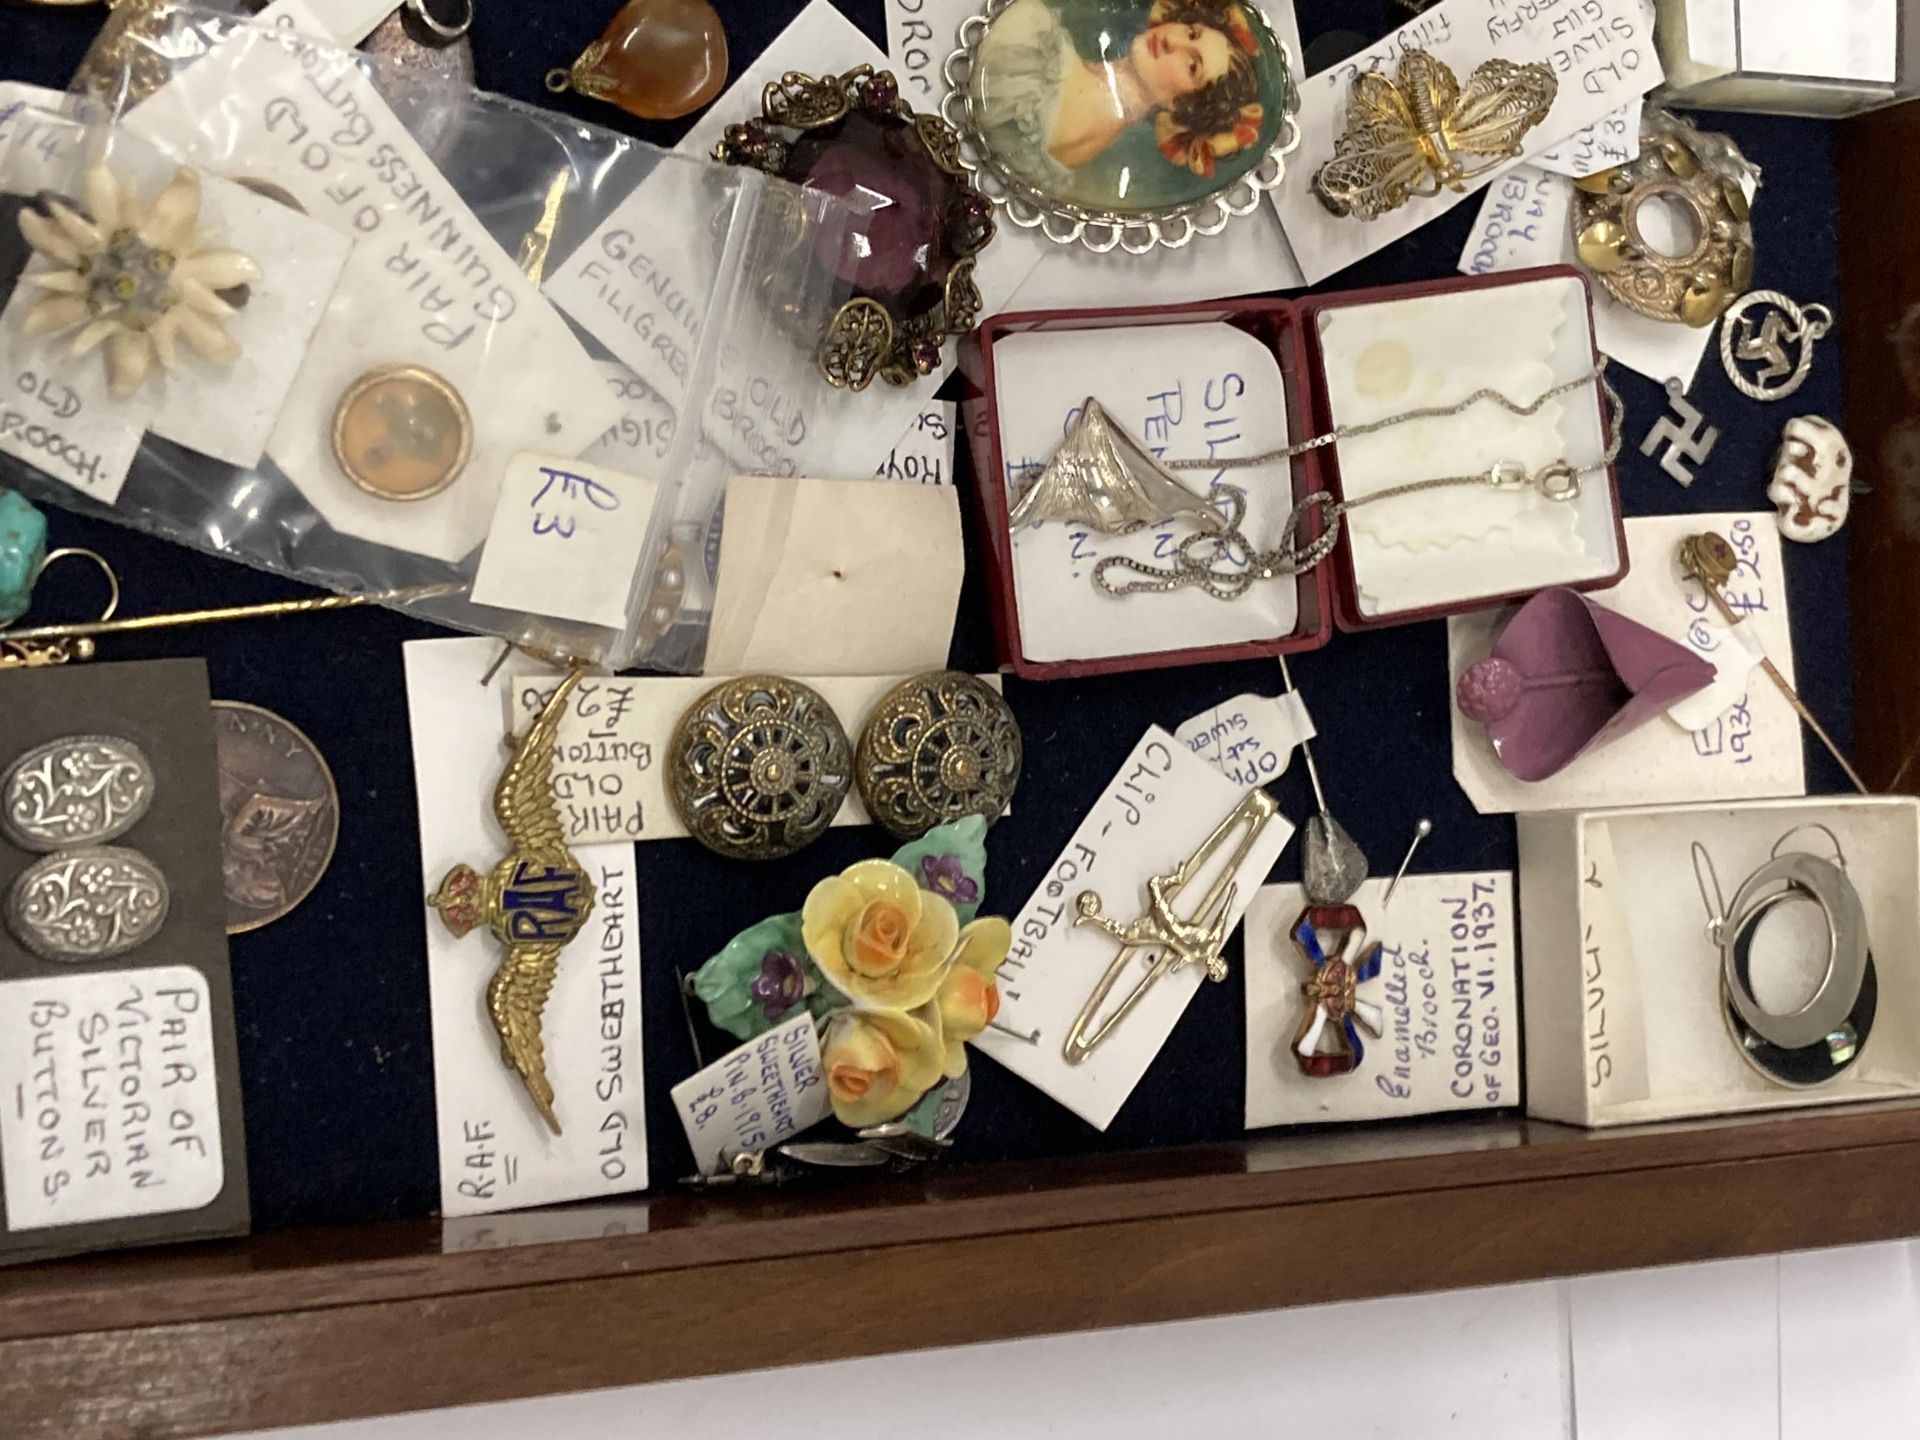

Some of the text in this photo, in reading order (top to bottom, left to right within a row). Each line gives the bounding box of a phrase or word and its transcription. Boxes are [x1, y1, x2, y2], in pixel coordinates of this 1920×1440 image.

[1583, 49, 1640, 94] OLD
[264, 97, 382, 234] OF OLD
[368, 143, 517, 323] GUINNESS
[385, 242, 476, 351] PAIR
[16, 370, 82, 419] OLD
[750, 376, 807, 447] OLD
[552, 772, 624, 801] OLD
[567, 801, 645, 839] PAIR
[1441, 898, 1474, 1098] CORONATION
[155, 986, 207, 1158] PAIR OF
[783, 1024, 820, 1096] SILVER
[1479, 1005, 1502, 1067] GEO.
[78, 1011, 112, 1179] SILVER
[116, 983, 167, 1189] VICTORIAN
[1485, 1073, 1502, 1102] OF
[600, 1109, 628, 1181] OLD
